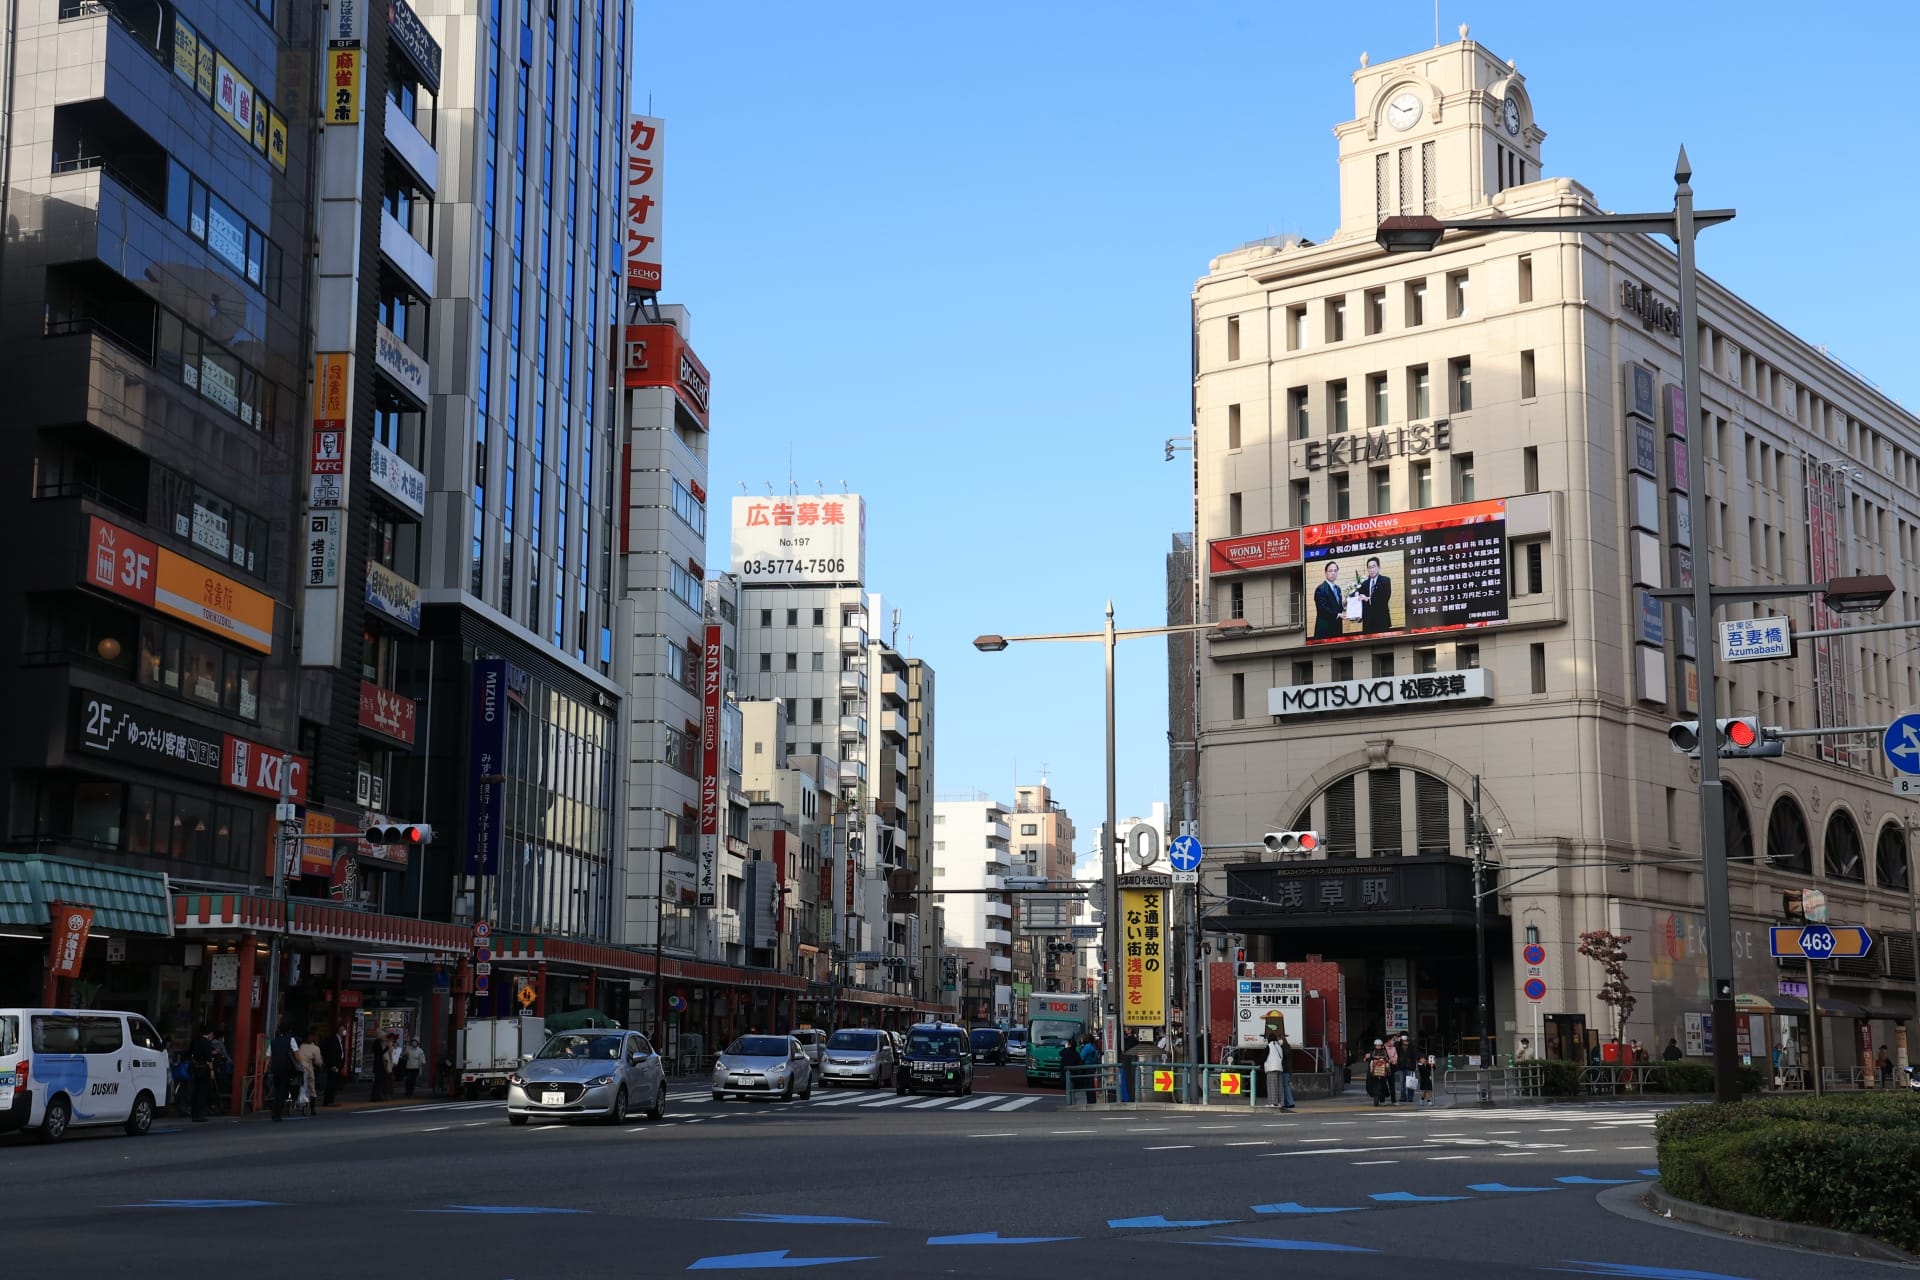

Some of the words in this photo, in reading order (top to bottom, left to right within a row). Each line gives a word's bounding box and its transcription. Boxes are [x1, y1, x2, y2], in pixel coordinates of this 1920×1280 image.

[395, 14, 428, 67] コミックカフェ
[335, 52, 353, 120] 麻雀カホ
[628, 121, 655, 257] カラオケ
[1305, 419, 1450, 472] EKIMISE
[315, 461, 341, 471] KFC
[746, 502, 845, 526] 広告募集
[1341, 518, 1398, 533] PhotoNews
[780, 538, 810, 547] No.197
[1230, 545, 1262, 557] WONDA
[121, 548, 150, 590] 3F
[744, 559, 845, 574] 03-5774-7506
[1727, 621, 1753, 631] 台東区
[1728, 628, 1782, 647] 吾妻橋
[1728, 643, 1784, 657] Azumabashi
[705, 644, 720, 695] カラオケ
[485, 672, 497, 722] MIZUHO
[1399, 674, 1466, 700] 松屋浅草
[84, 700, 112, 736] 2F
[406, 704, 414, 720] 3F
[128, 722, 187, 760] ゆったり客席
[702, 775, 718, 828] カラオケ
[1279, 878, 1389, 907] 浅草駅
[1144, 894, 1159, 972] 交通事故の
[1802, 933, 1832, 951] 463
[1127, 910, 1142, 1005] ない街浅草を
[1049, 1002, 1069, 1012] TDC
[91, 1083, 119, 1096] DUSKIN
